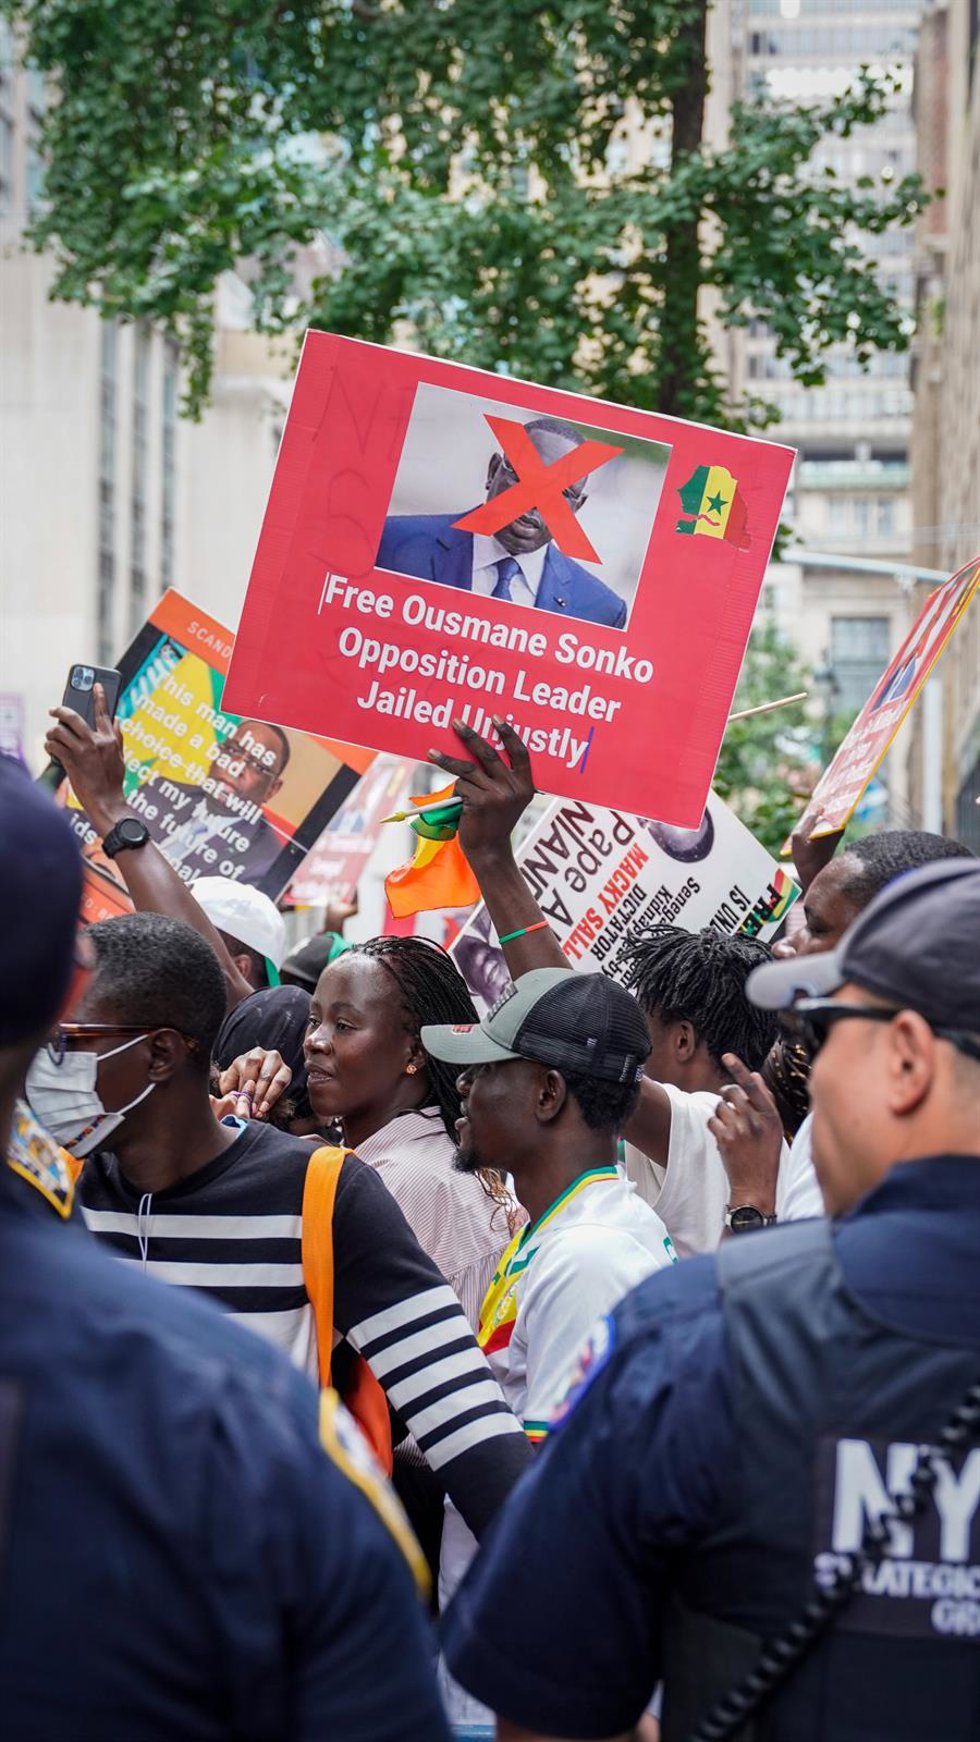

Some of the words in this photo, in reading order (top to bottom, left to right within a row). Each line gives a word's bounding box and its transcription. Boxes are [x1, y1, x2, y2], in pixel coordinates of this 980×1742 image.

[187, 620, 231, 659] SCAND
[325, 574, 394, 618] Free
[402, 595, 547, 657] Ousmane
[554, 633, 654, 683] Sonko
[339, 627, 506, 695] Opposition
[513, 670, 621, 723] Leader
[137, 692, 188, 737] made
[189, 733, 203, 750] a
[206, 742, 246, 778] bad
[195, 702, 238, 740] man
[238, 730, 276, 766] has
[357, 681, 454, 728] Jailed
[461, 704, 589, 769] Unjustly
[120, 717, 182, 767] choice
[185, 762, 227, 799] that
[224, 792, 264, 825] will
[158, 780, 192, 811] my
[125, 789, 158, 821] the
[160, 813, 217, 864] fuure
[564, 810, 635, 893] Pape
[597, 842, 649, 916] MACKY
[729, 885, 751, 912] IS
[738, 883, 783, 936] FRE
[562, 907, 604, 960] SALL
[590, 883, 647, 962] DICTATOR
[616, 885, 673, 964] Kidnaped
[709, 902, 740, 936] UNL
